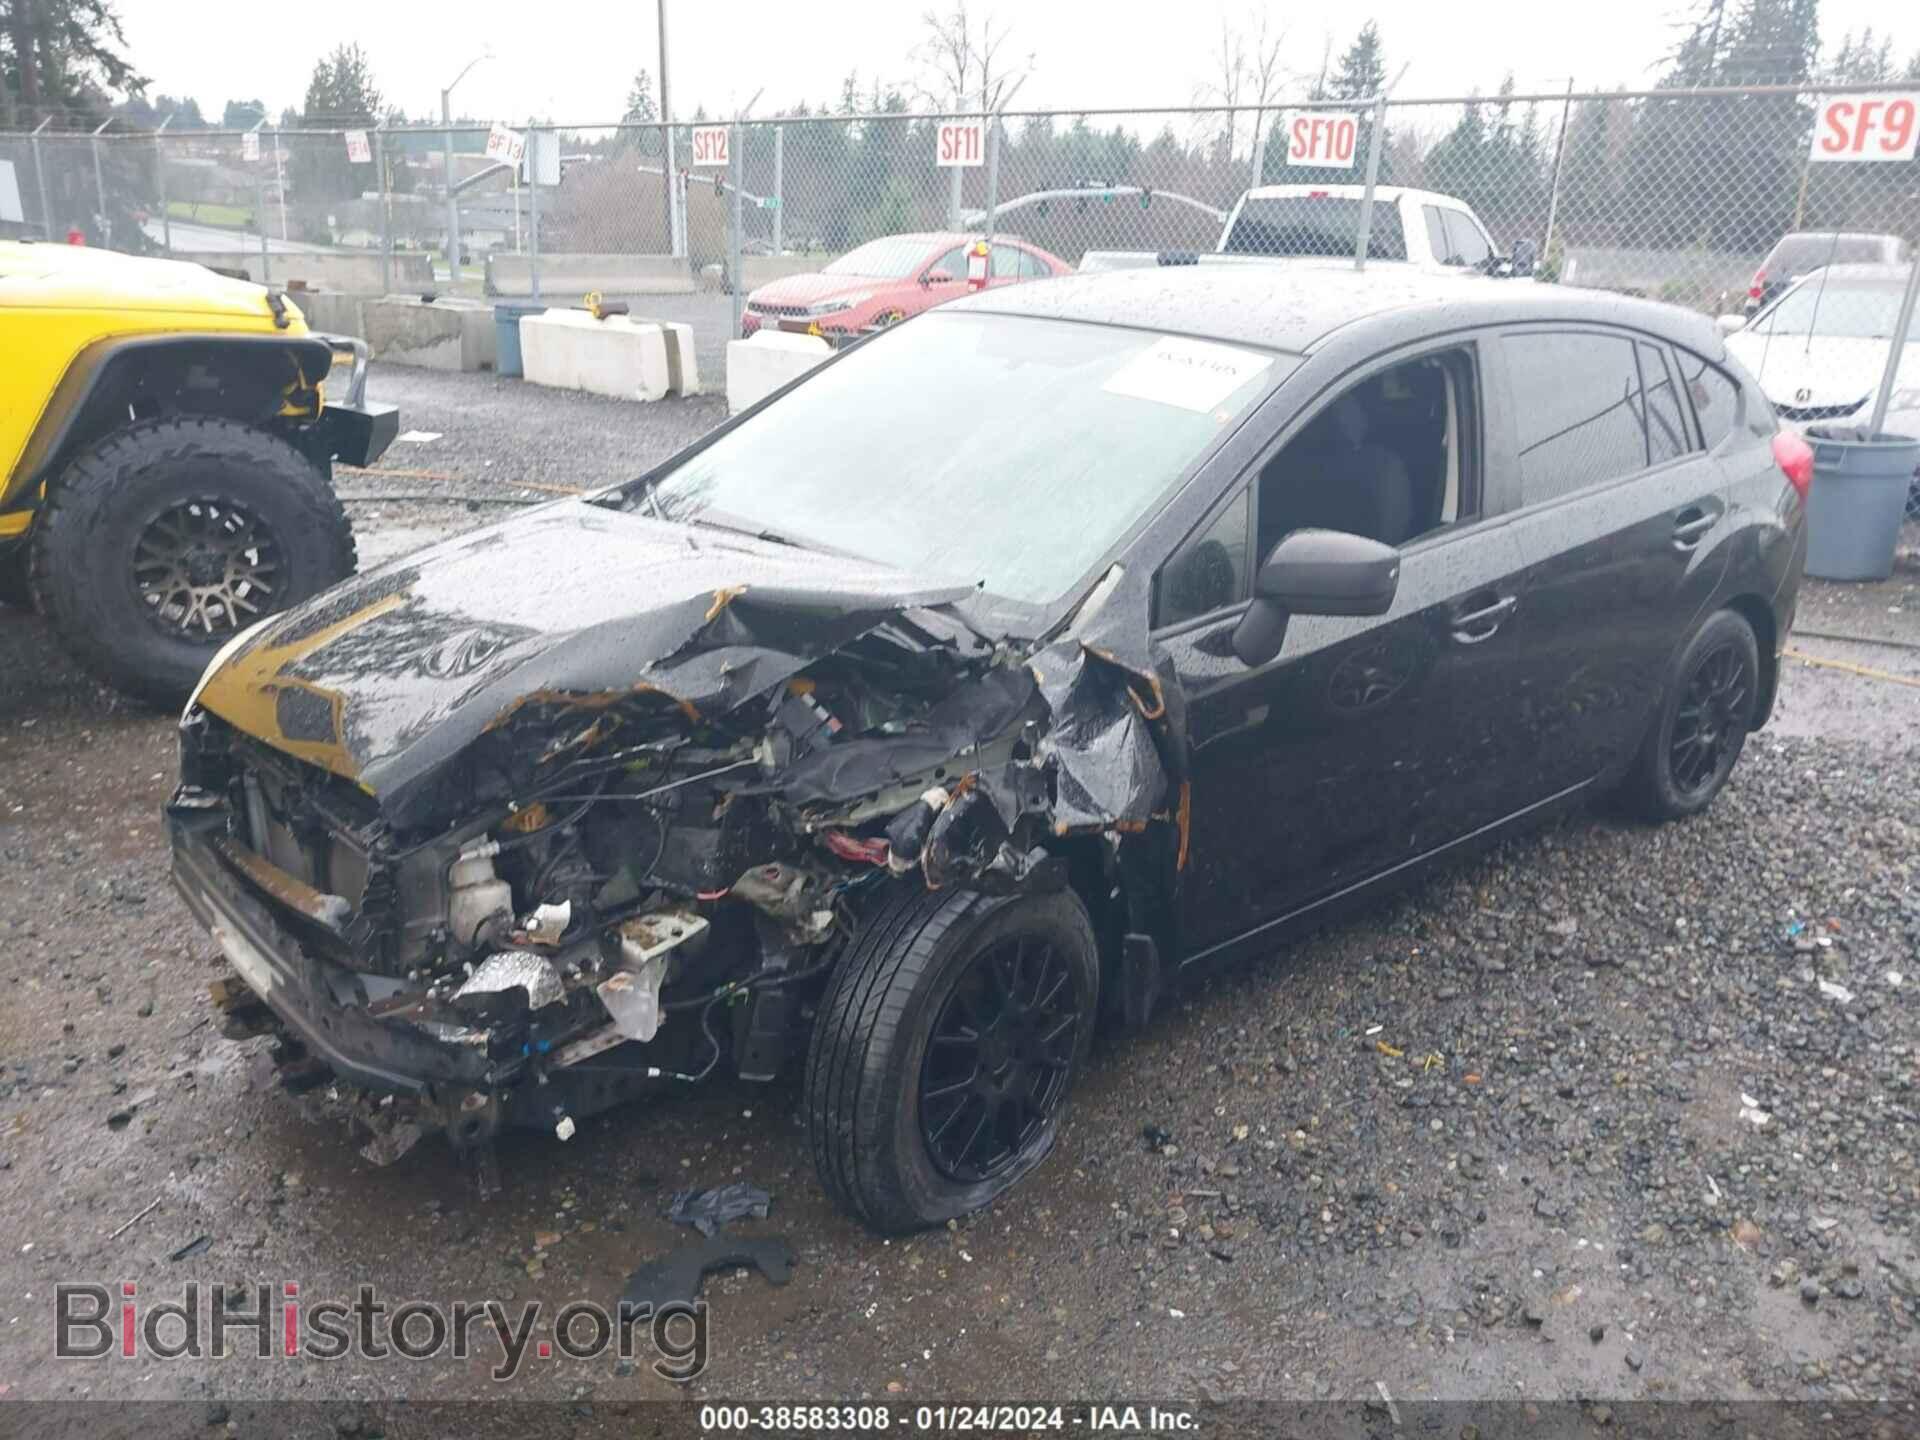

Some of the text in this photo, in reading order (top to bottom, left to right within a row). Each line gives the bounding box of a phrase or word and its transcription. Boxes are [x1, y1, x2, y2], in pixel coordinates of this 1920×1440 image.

[942, 126, 979, 160] SF11
[1291, 117, 1355, 160] SF10
[1822, 99, 1915, 153] SF9
[694, 131, 727, 160] SF12
